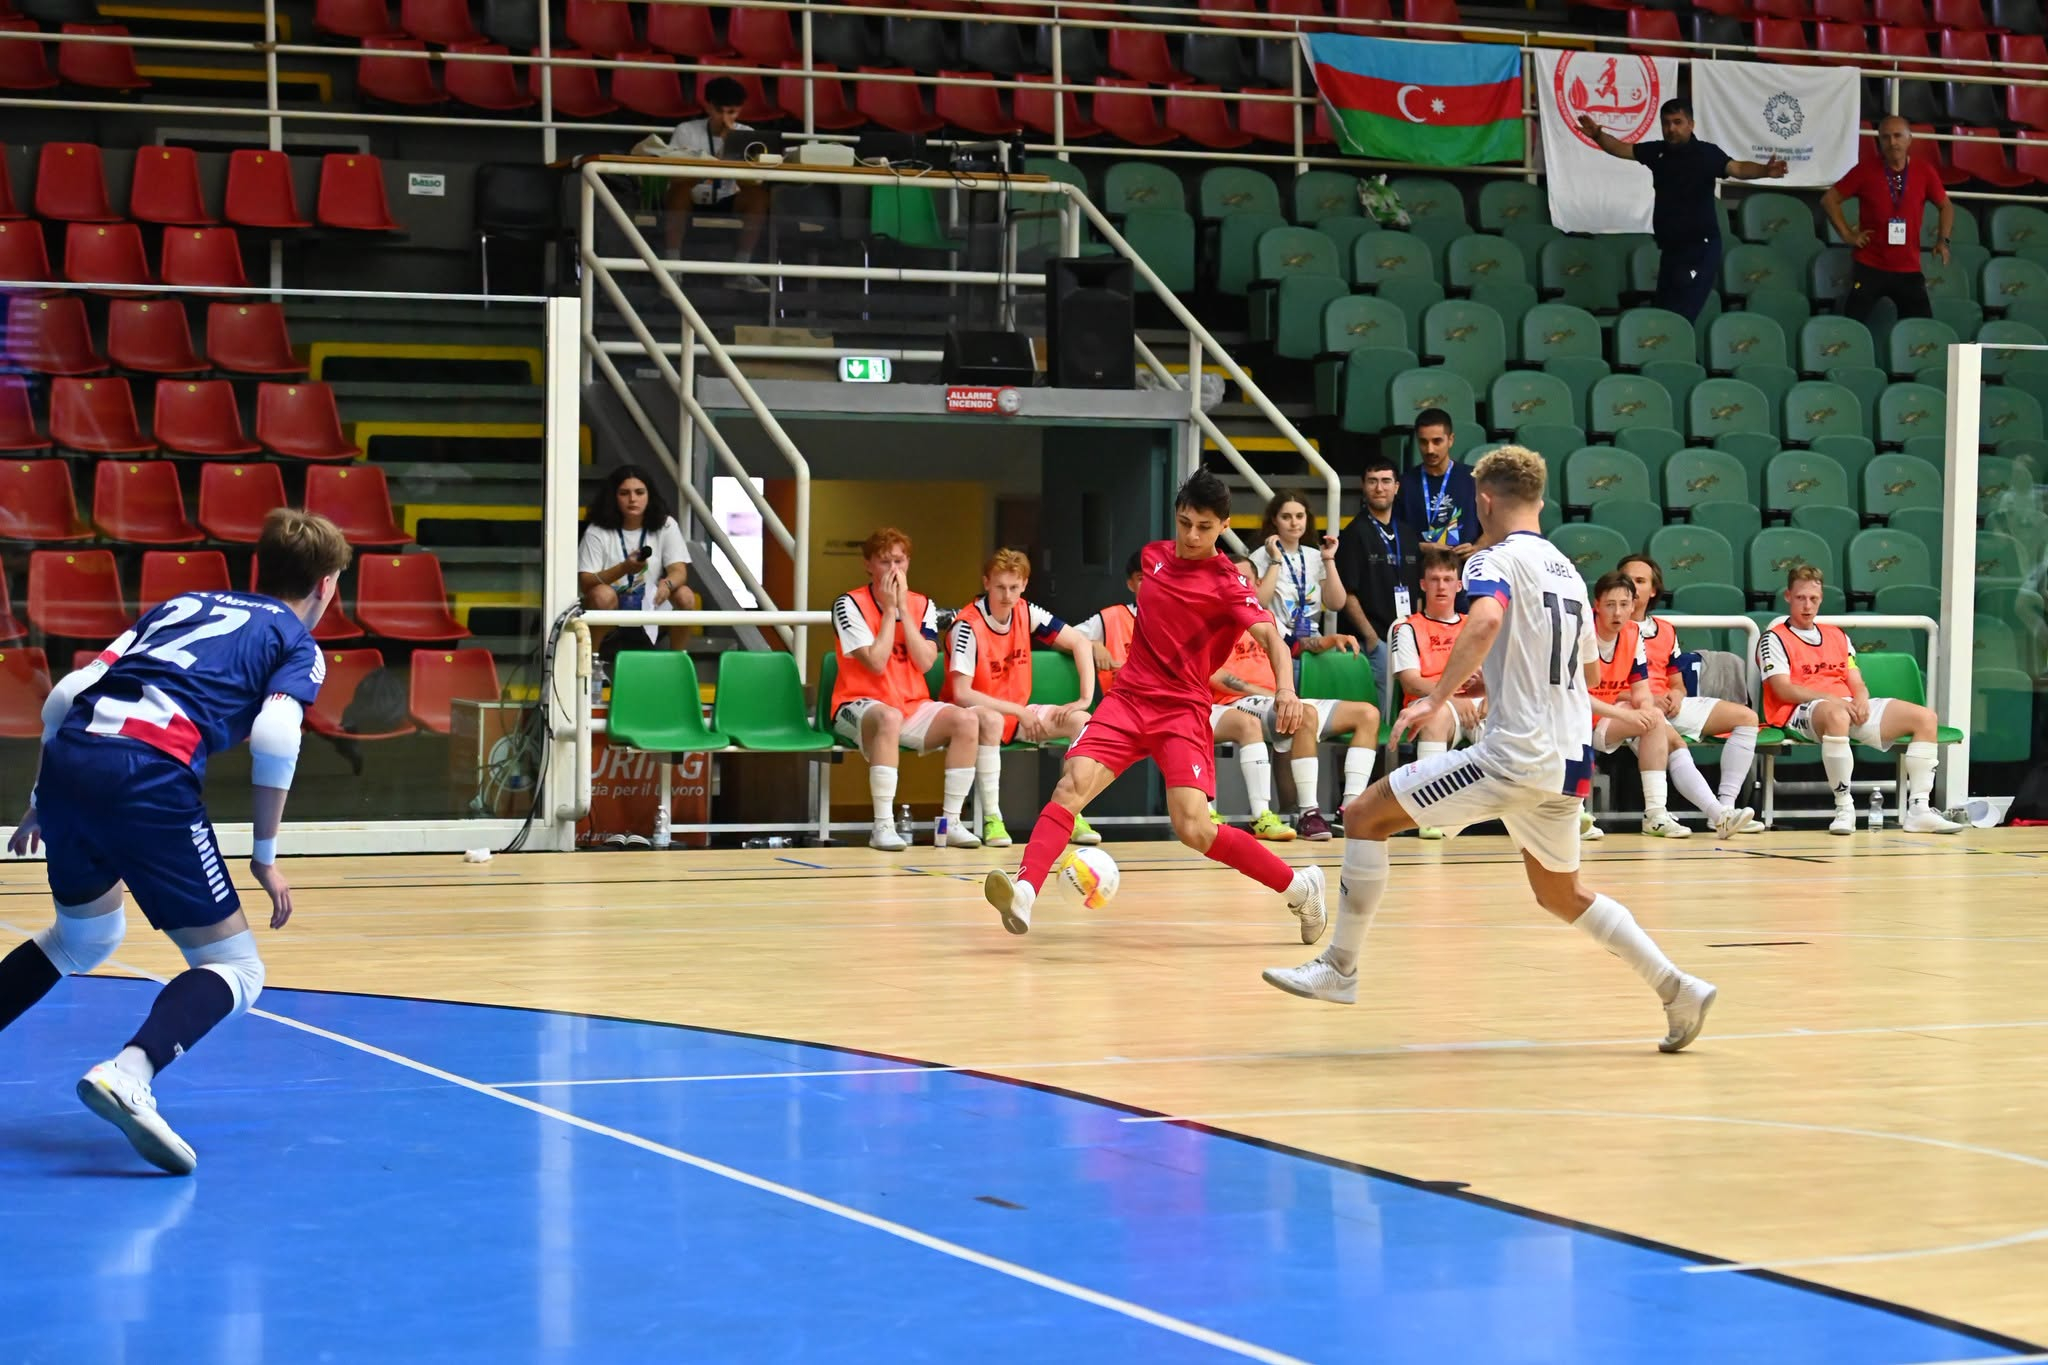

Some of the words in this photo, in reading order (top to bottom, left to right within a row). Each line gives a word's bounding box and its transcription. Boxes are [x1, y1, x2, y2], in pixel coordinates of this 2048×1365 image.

[949, 400, 993, 408] INCENDIO
[950, 392, 993, 400] ALLARME
[124, 596, 251, 670] 22
[1543, 591, 1583, 690] 17
[613, 785, 638, 799] per
[641, 783, 651, 796] il
